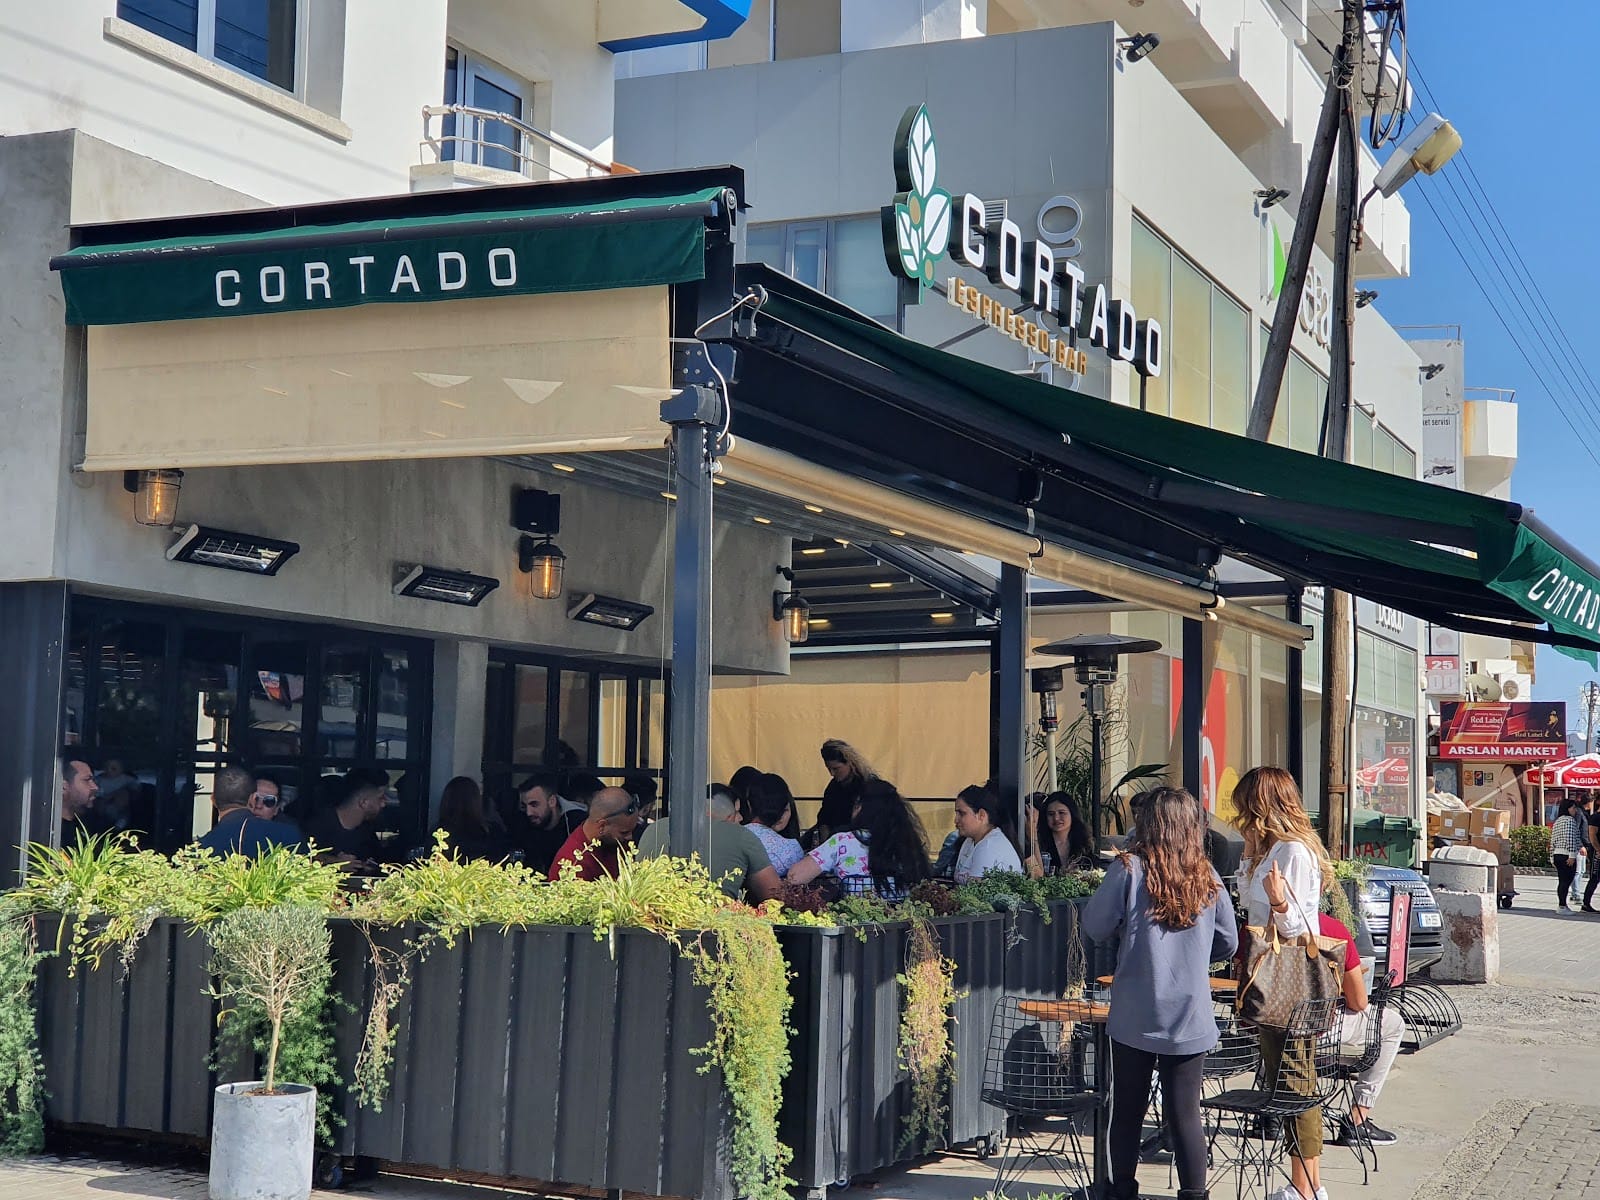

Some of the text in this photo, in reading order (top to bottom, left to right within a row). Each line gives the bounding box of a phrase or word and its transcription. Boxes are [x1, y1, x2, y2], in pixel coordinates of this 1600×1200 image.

[214, 246, 518, 308] CORTADO
[961, 192, 1162, 378] CORTADO
[952, 276, 1088, 376] ESPRESSO BAR
[1527, 567, 1600, 634] CORTAD
[1470, 715, 1504, 724] Red Label
[1448, 746, 1558, 756] ARSLAN MARKET
[1570, 777, 1599, 785] ALGIDA
